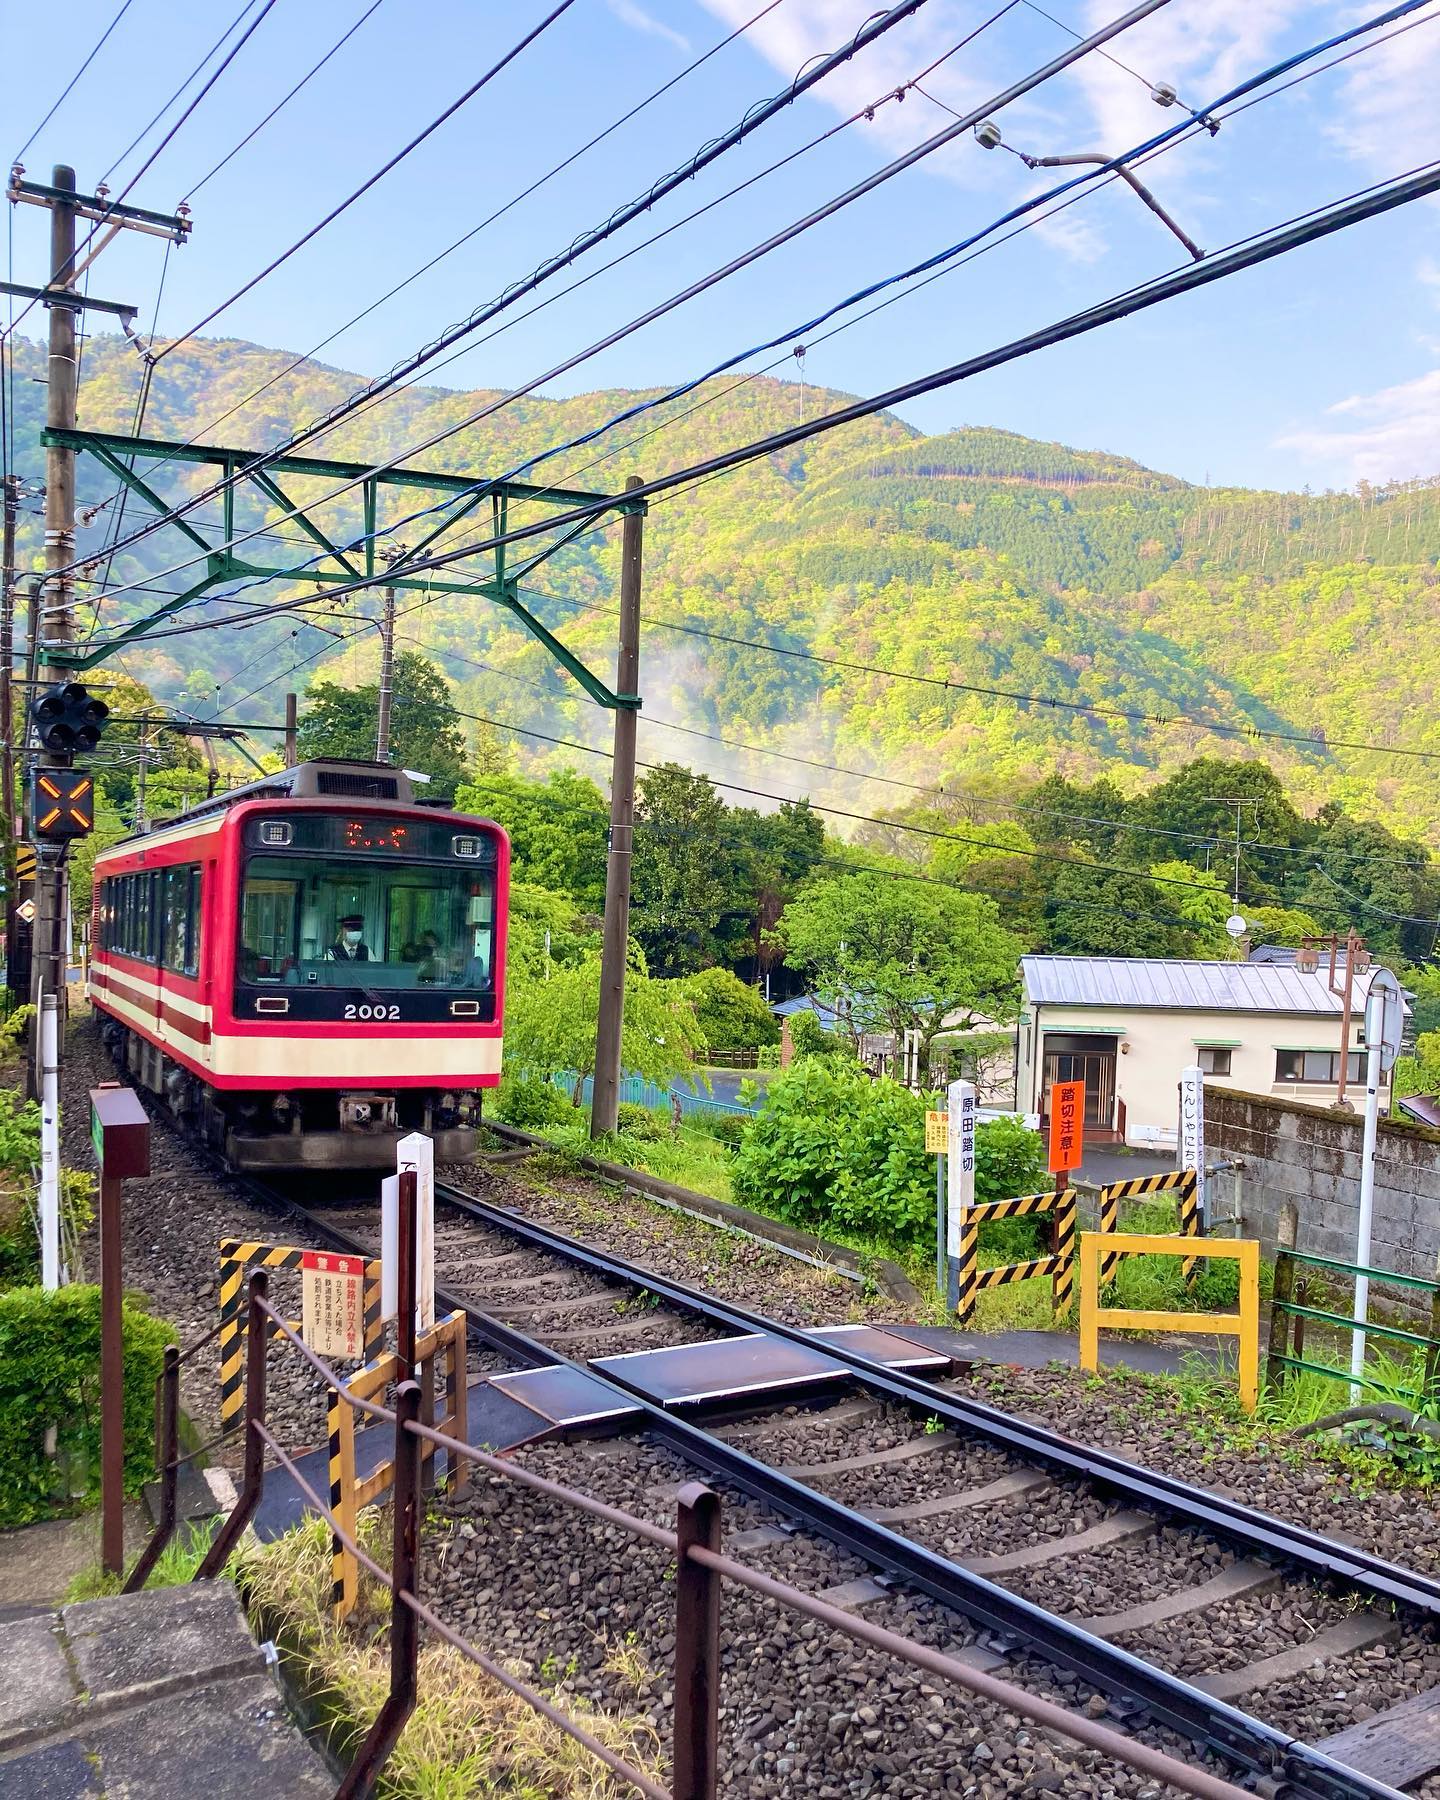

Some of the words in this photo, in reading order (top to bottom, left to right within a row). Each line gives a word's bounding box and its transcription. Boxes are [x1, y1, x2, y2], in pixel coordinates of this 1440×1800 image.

[345, 1005, 400, 1019] 2002
[962, 1097, 974, 1172] 原田踏切
[1060, 1087, 1075, 1165] 踏切注意！
[317, 1257, 349, 1272] 警告
[324, 1278, 332, 1351] 鉄道営業法等により
[335, 1280, 343, 1336] 立ち入った場合
[346, 1278, 357, 1354] 線路内立入禁止
